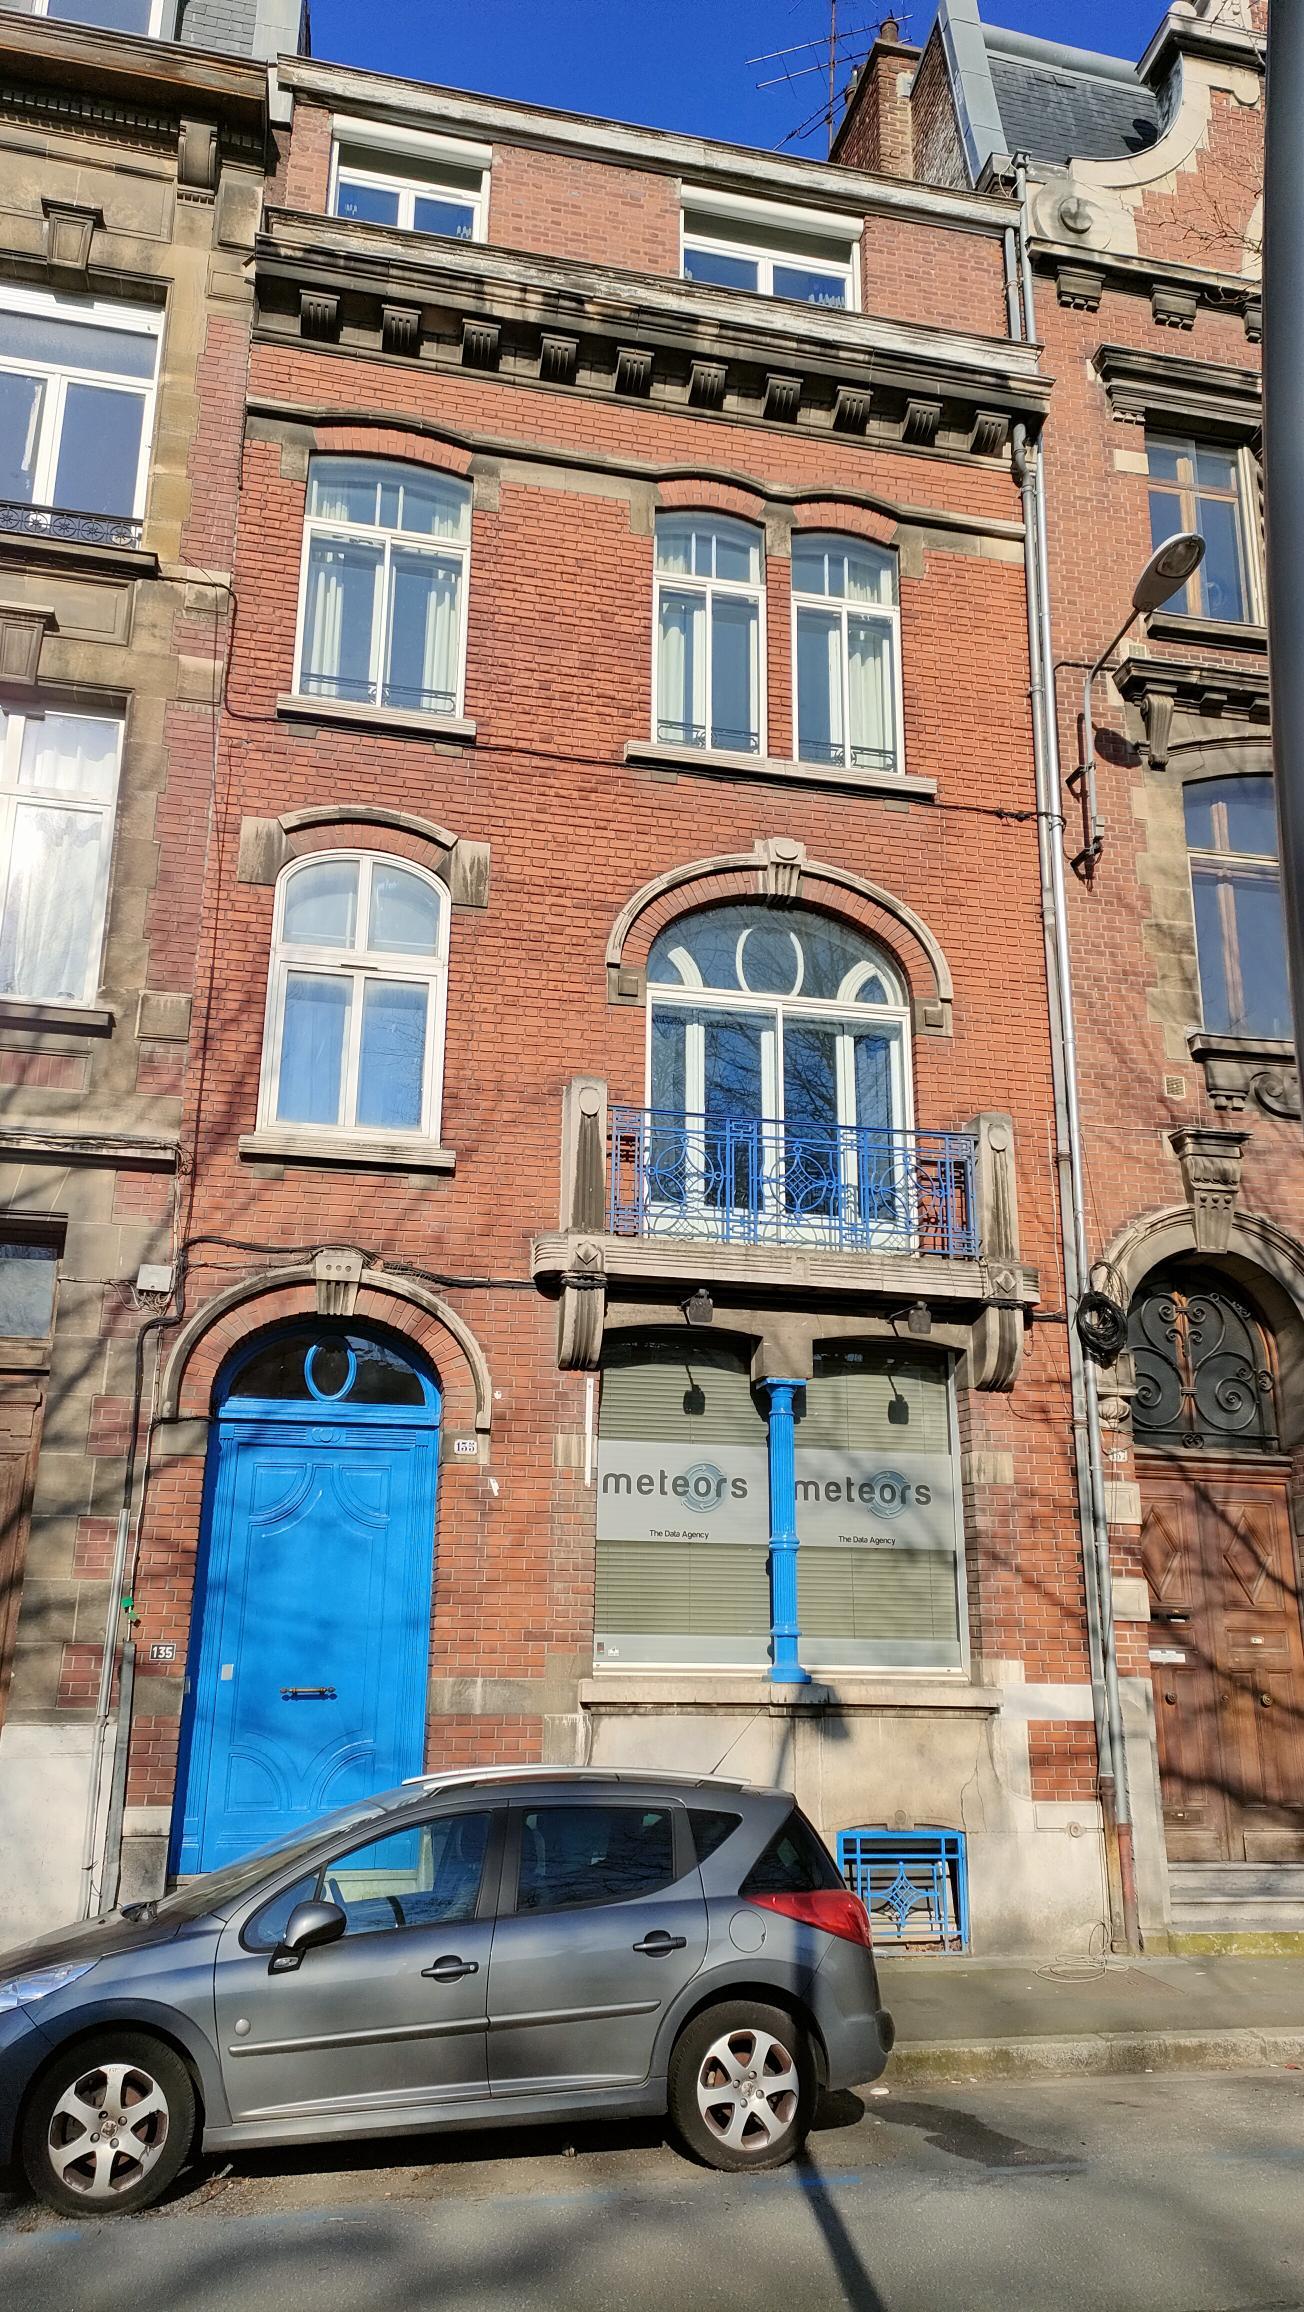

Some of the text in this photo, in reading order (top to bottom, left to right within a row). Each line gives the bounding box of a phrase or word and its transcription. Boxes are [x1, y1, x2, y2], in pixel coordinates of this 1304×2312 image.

[602, 1469, 748, 1499] meteors
[795, 1477, 932, 1506] meteors
[649, 1529, 710, 1540] The Data Agency
[838, 1535, 896, 1546] The Data Agency
[152, 1646, 173, 1659] 135
